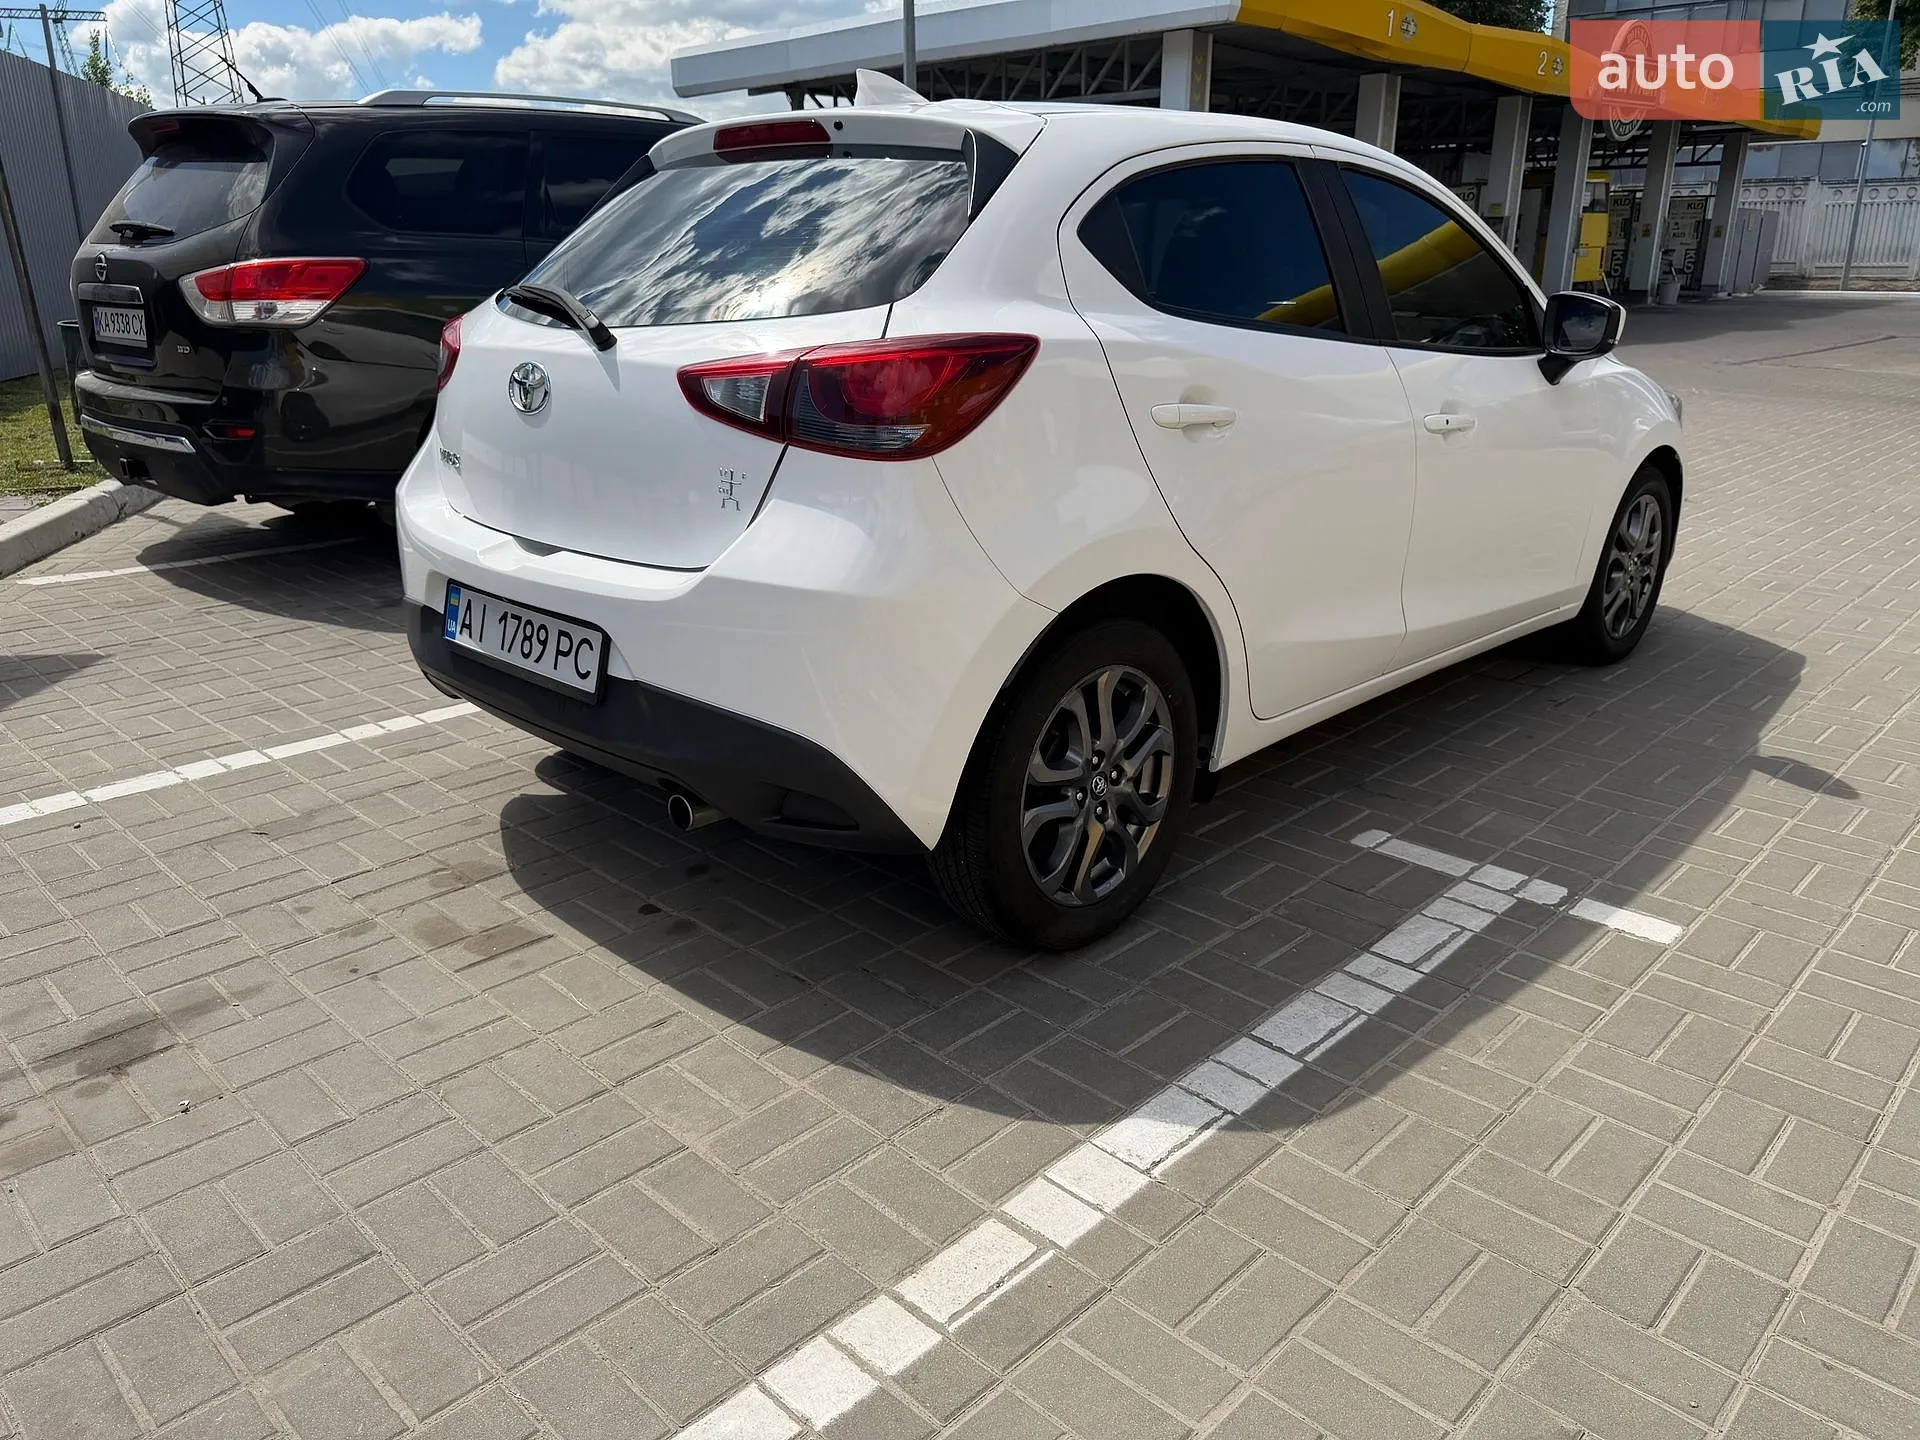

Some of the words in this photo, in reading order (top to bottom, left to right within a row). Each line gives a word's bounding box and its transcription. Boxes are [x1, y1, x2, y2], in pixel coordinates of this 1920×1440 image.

[1386, 9, 1395, 37] 1
[1537, 51, 1548, 75] 2
[131, 313, 146, 336] CX
[459, 598, 486, 643] AI
[498, 610, 549, 664] 1789
[553, 629, 594, 680] PC
